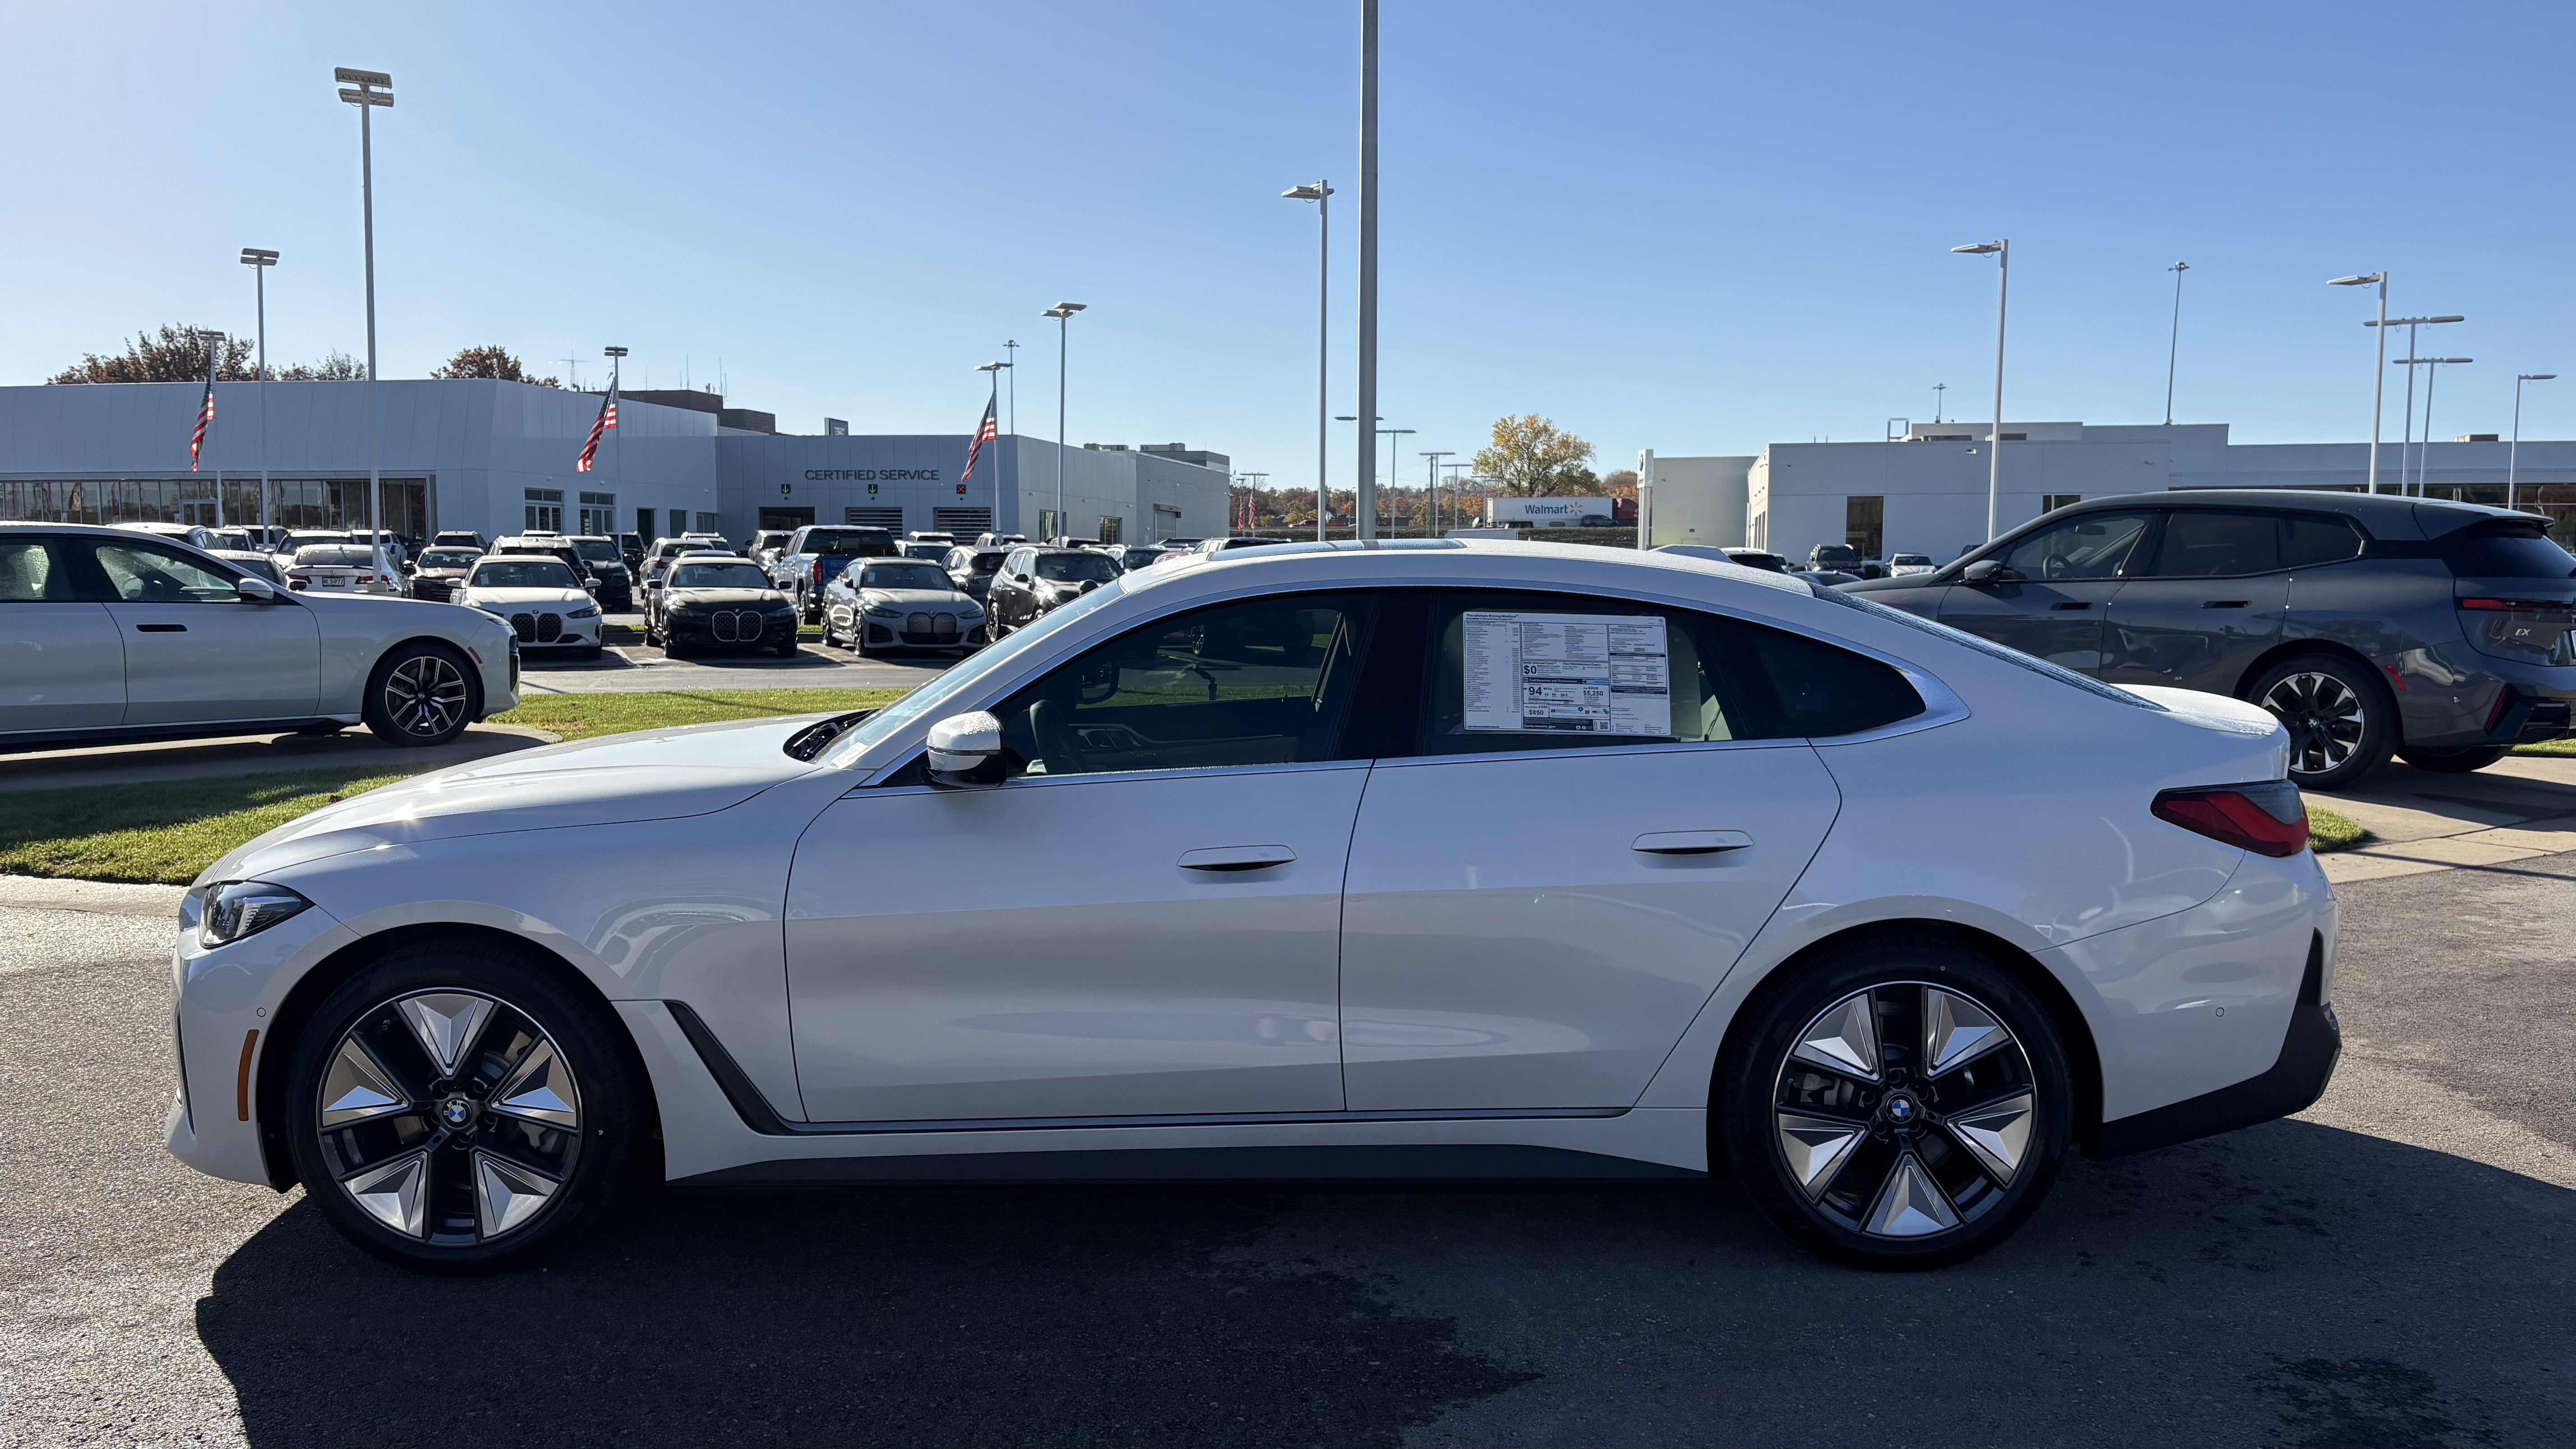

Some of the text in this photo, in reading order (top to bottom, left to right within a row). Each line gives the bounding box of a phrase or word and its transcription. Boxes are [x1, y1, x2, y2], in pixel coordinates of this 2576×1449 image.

[805, 470, 940, 480] CERTIFIED SERVICE
[1525, 504, 1568, 514] Walmart
[1524, 665, 1537, 674] $0
[1528, 686, 1542, 695] 94
[443, 1099, 463, 1116] BMW
